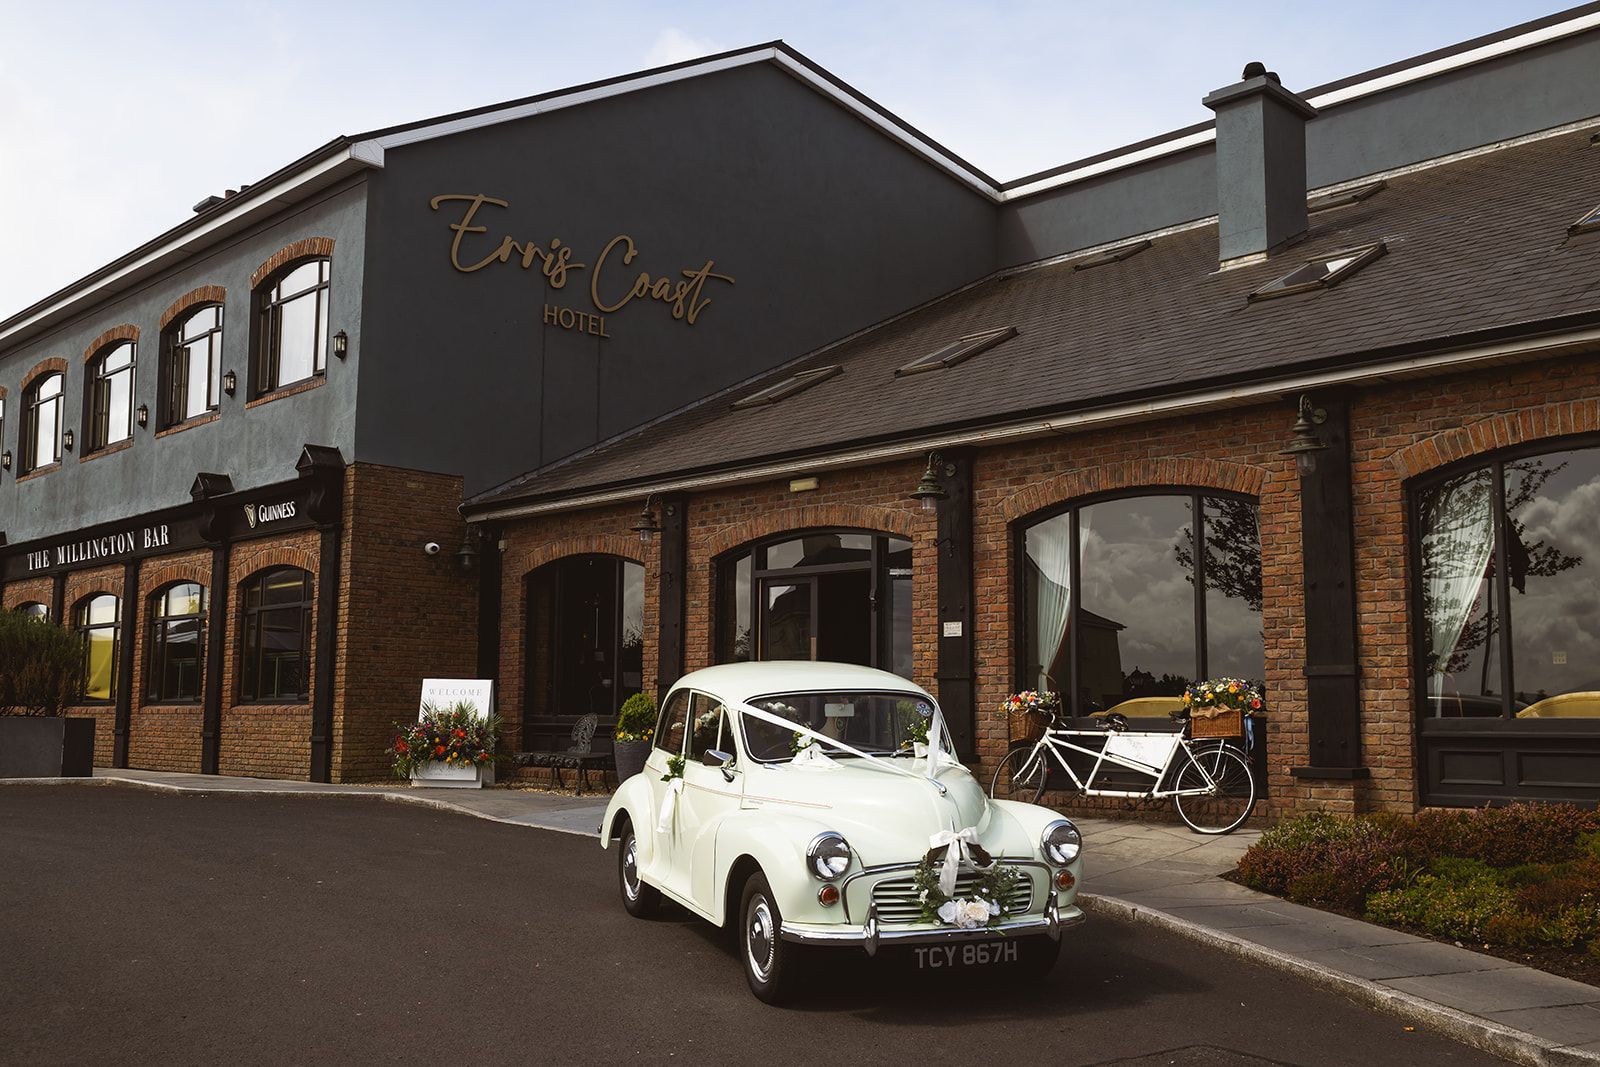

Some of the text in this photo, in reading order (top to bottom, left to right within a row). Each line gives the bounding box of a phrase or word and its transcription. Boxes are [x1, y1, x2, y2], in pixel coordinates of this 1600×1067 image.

[430, 193, 736, 325] Erris Coast
[543, 303, 610, 338] HOTEL
[27, 524, 170, 571] THE MILLINGTON BAR
[428, 688, 483, 696] WELCOME
[914, 941, 1018, 969] TCY 867H
